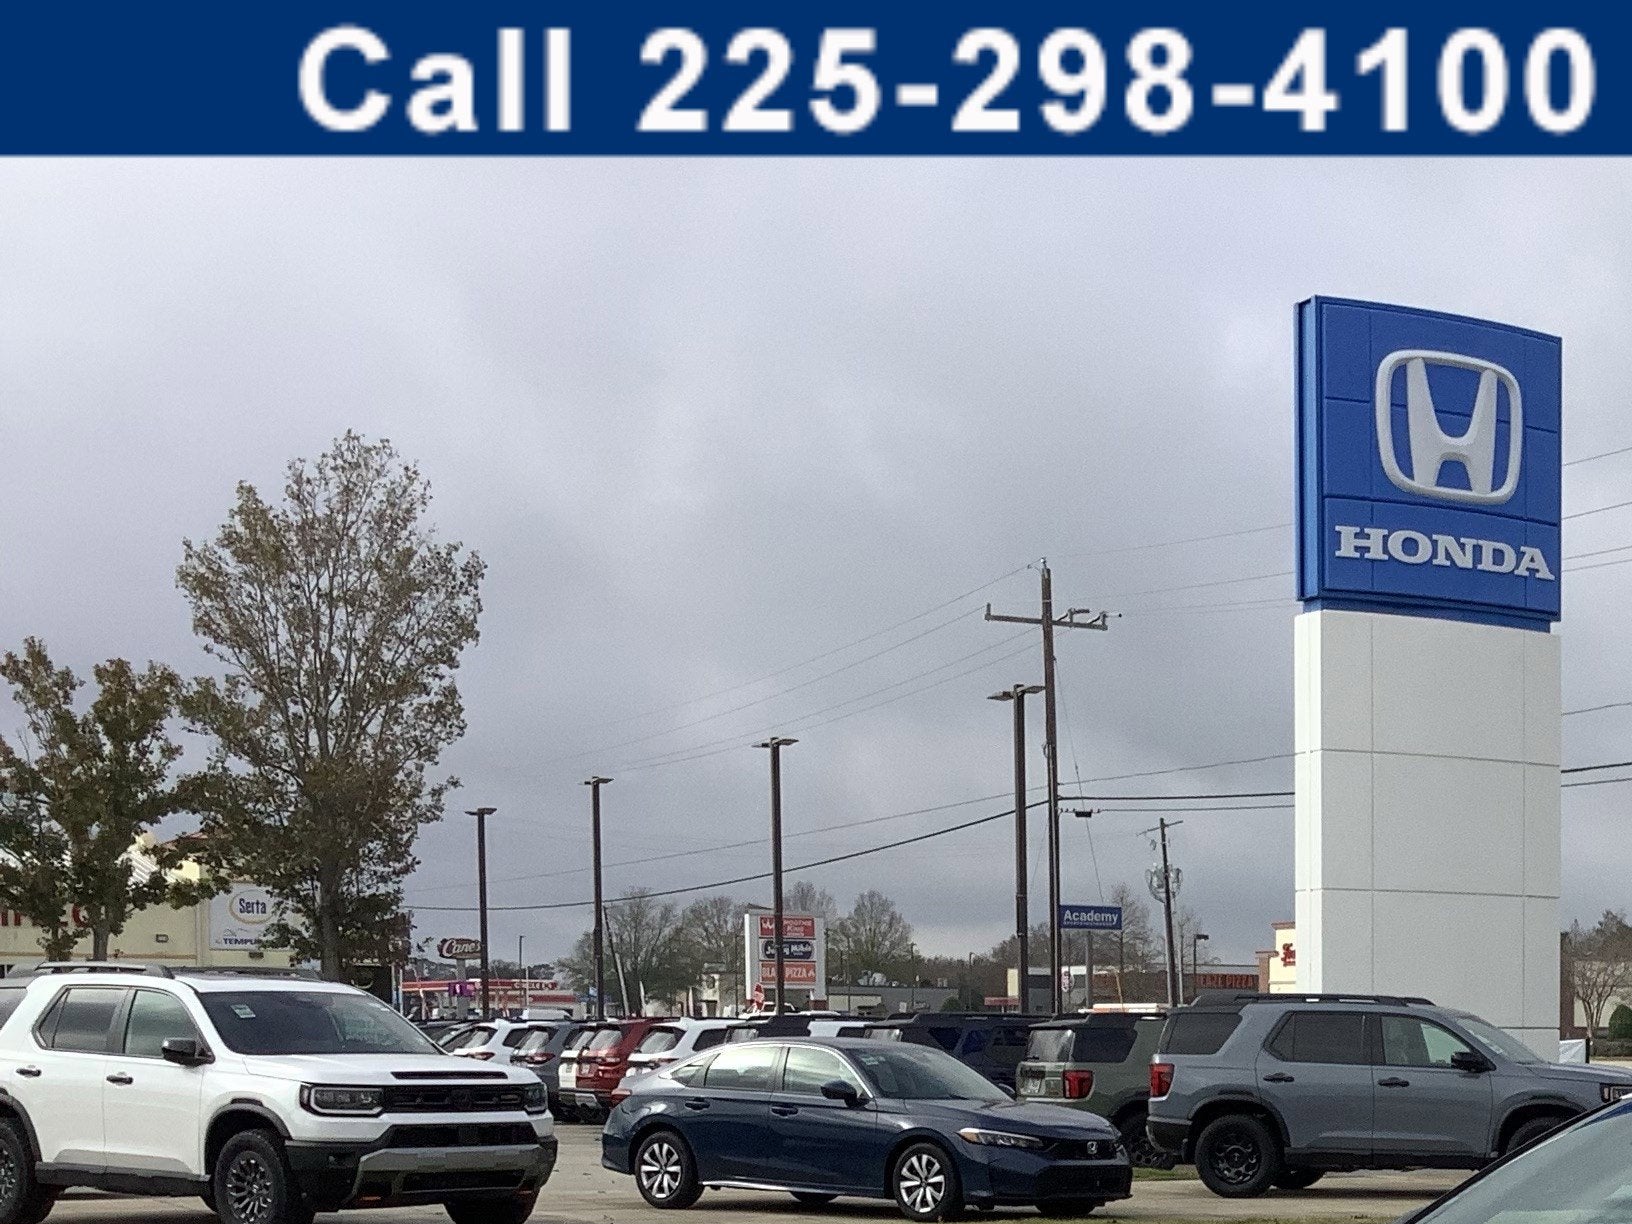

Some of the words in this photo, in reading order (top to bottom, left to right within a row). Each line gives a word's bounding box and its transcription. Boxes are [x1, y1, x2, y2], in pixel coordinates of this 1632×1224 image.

[1335, 525, 1555, 580] HONDA
[239, 898, 267, 914] Serta
[1063, 909, 1119, 925] Academy
